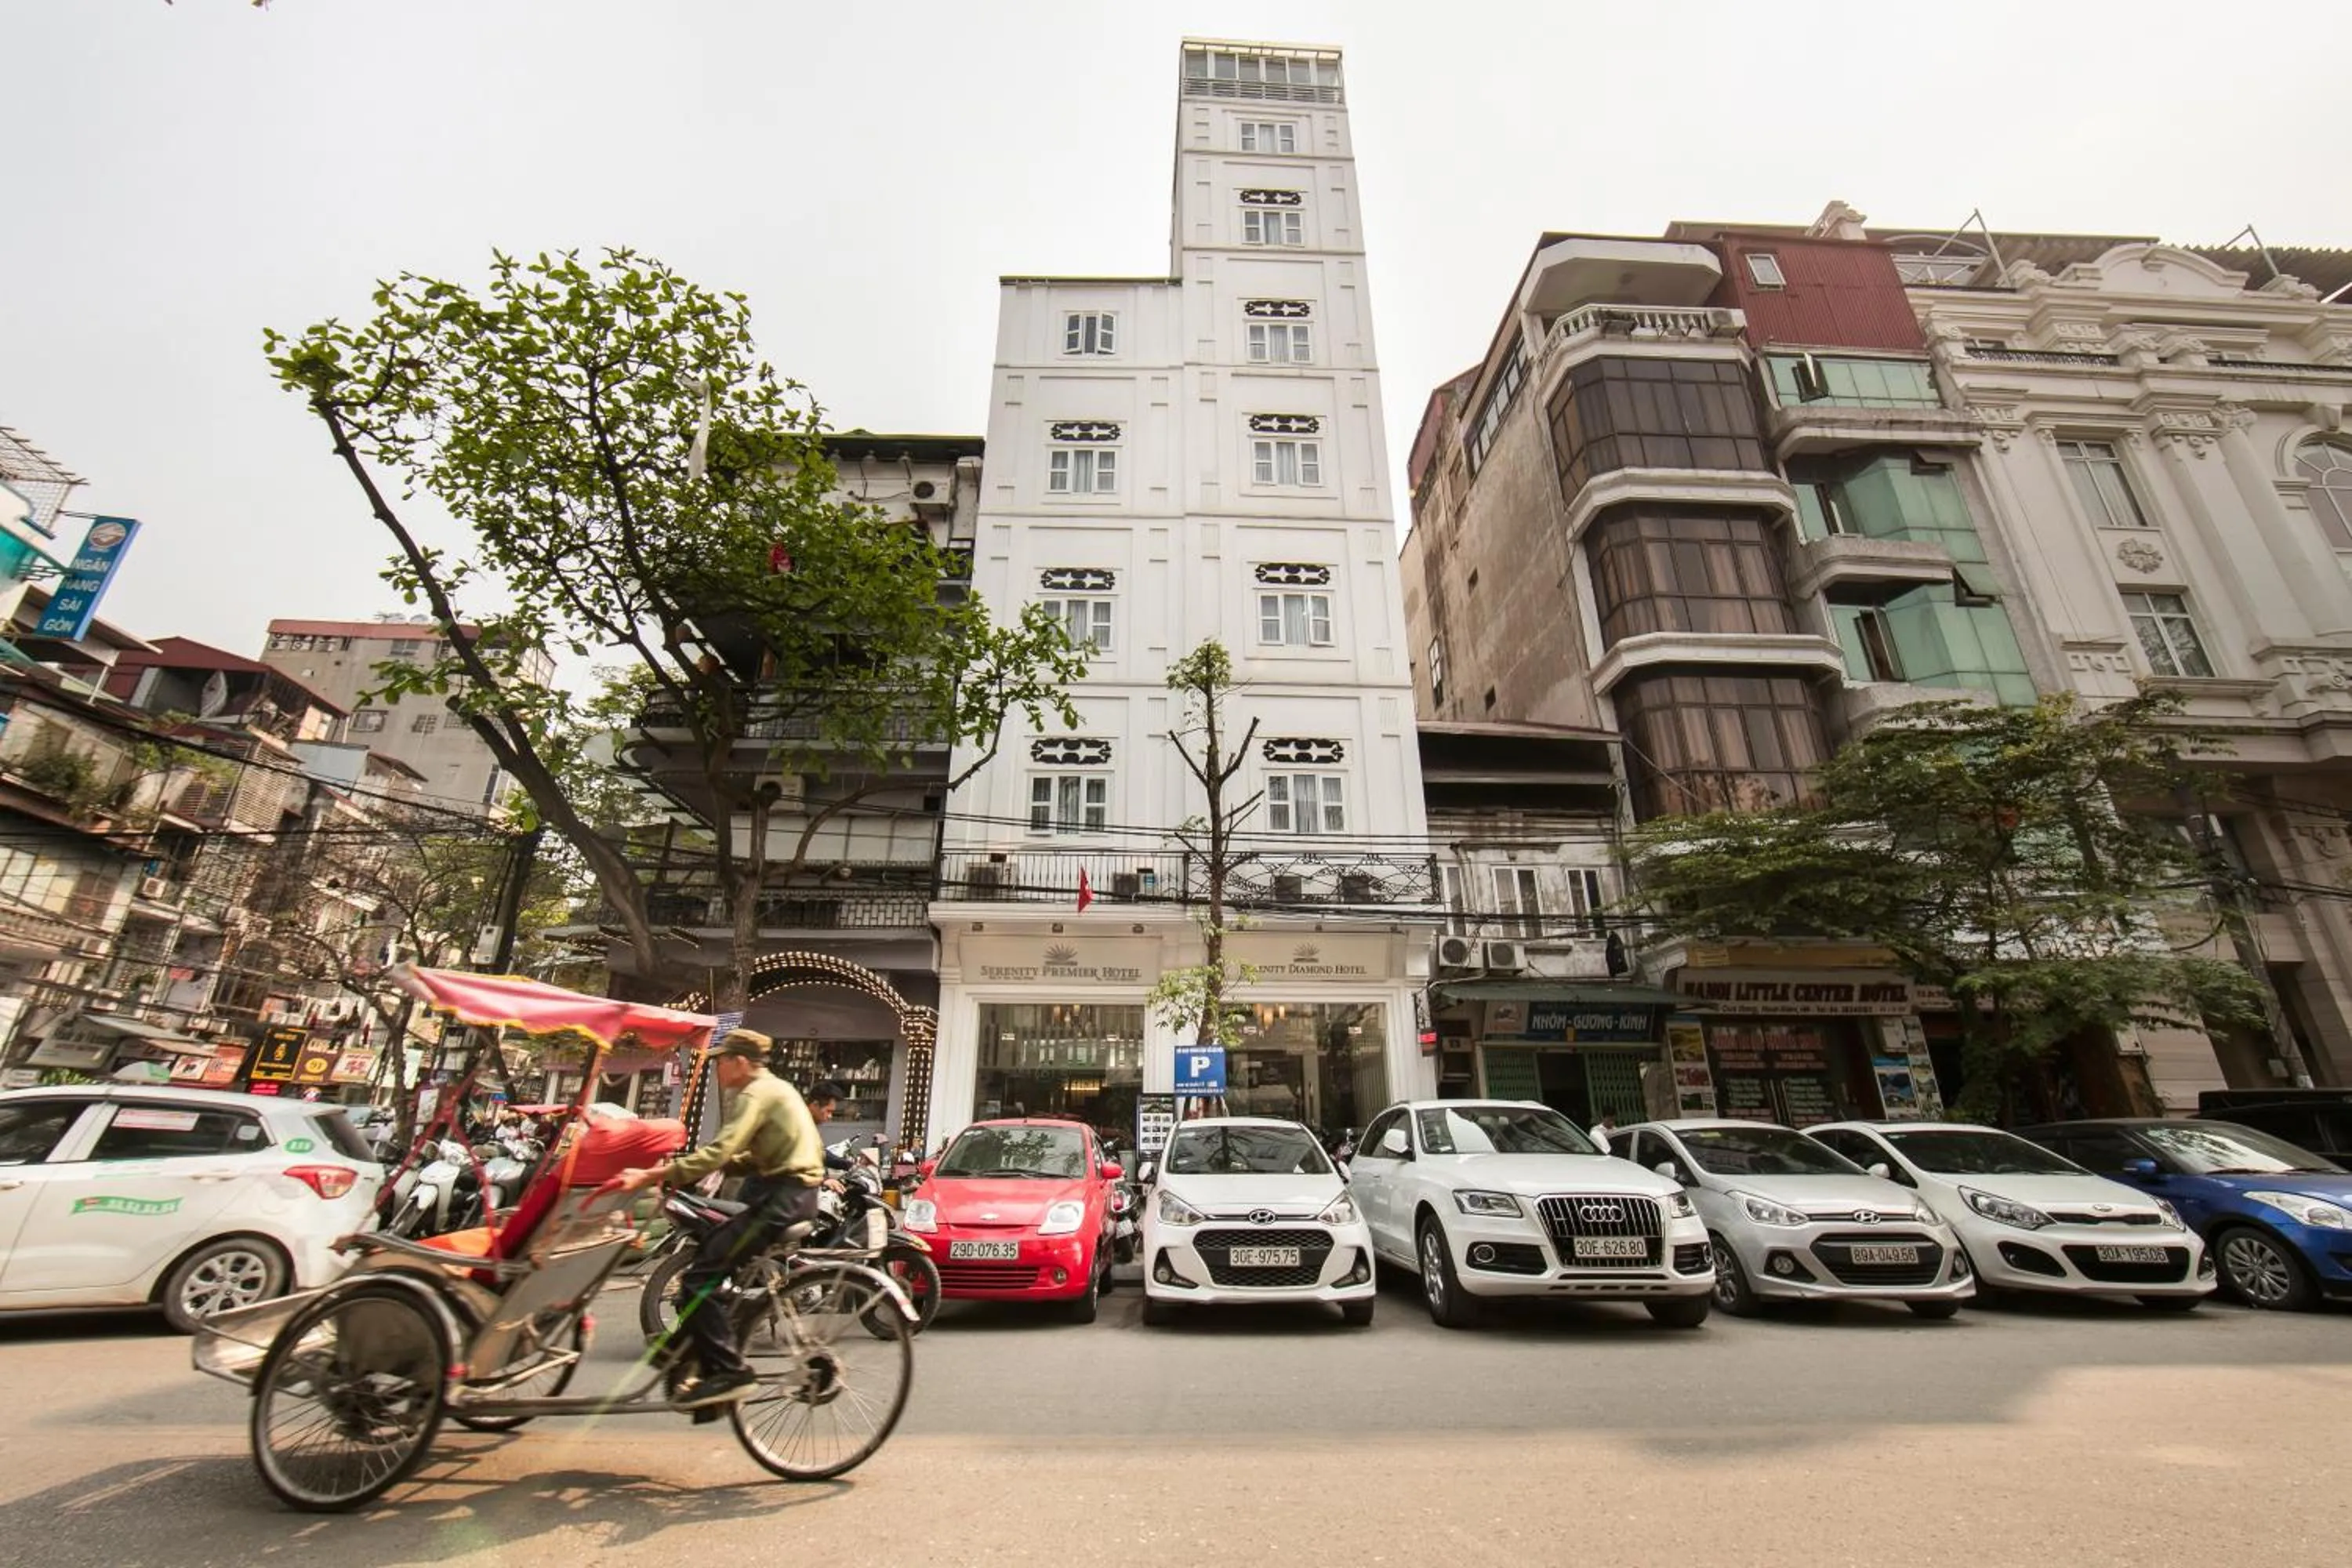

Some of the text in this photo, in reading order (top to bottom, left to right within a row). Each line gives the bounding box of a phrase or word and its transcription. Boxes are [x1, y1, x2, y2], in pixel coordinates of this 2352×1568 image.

[980, 965, 1142, 978] SERENITY PREMIER HOTEL
[1288, 964, 1333, 975] DIAMOND
[1335, 964, 1367, 975] HOTEL
[1190, 1055, 1211, 1078] P
[1577, 1240, 1645, 1255] 30E-626.80
